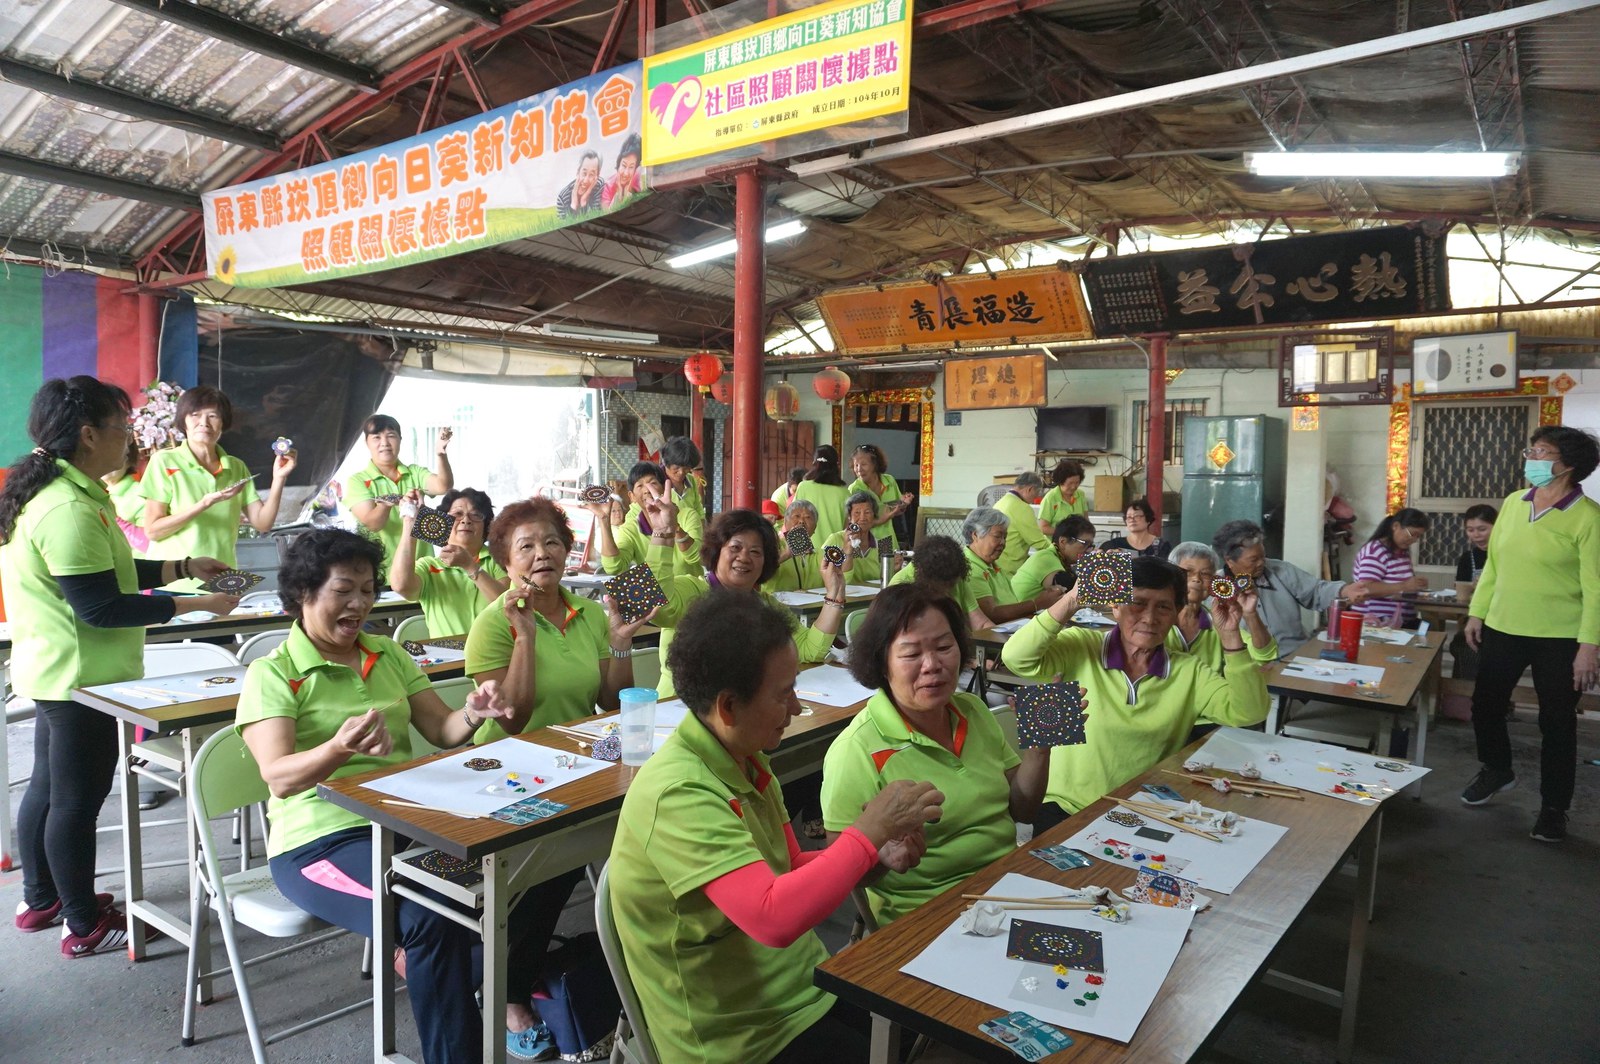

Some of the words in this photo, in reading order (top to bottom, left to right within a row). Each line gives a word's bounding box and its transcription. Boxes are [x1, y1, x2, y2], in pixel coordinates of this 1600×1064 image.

[704, 0, 903, 73] 屏東縣崁頂鄉向日葵新知協會
[705, 41, 900, 117] 社區照顧關懷據點
[213, 74, 635, 236] 屏東縣崁頂鄉向日葵新知協會
[760, 109, 800, 127] 屏東縣政府
[300, 188, 488, 272] 照顧關懷據點
